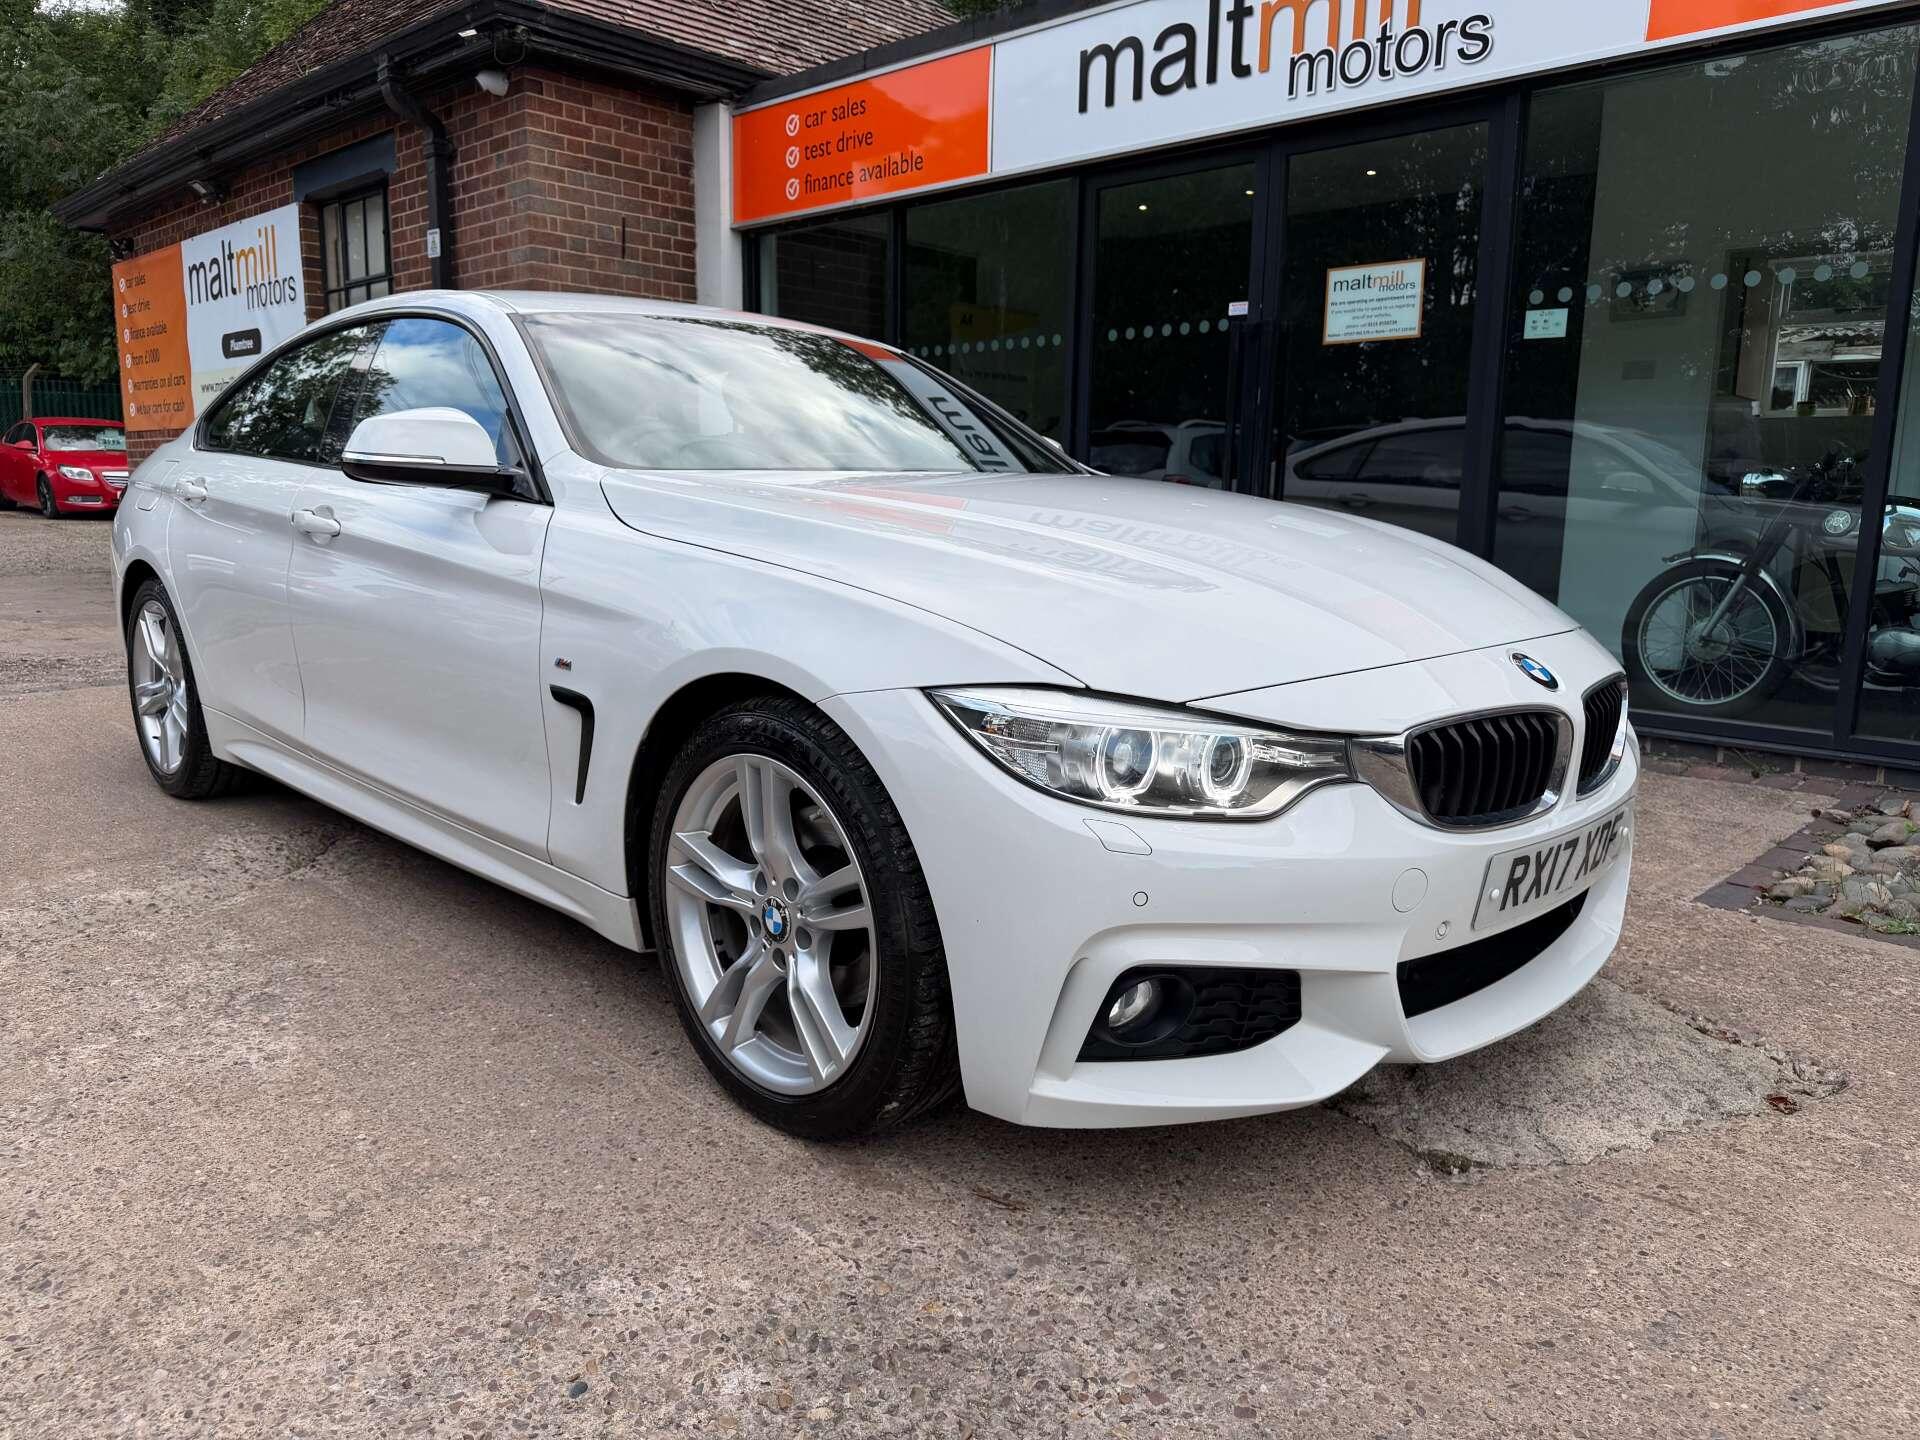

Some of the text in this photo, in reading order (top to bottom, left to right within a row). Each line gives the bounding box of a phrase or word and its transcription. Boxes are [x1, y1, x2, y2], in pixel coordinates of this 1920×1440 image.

[1288, 13, 1493, 98] motors
[804, 97, 867, 128] car sales
[804, 130, 873, 161] test drive
[804, 150, 924, 195] finance available
[188, 224, 277, 306] maltmill
[1333, 270, 1404, 292] maltmill
[246, 276, 297, 310] motors
[1378, 281, 1416, 292] motors
[1499, 836, 1580, 912] RX17
